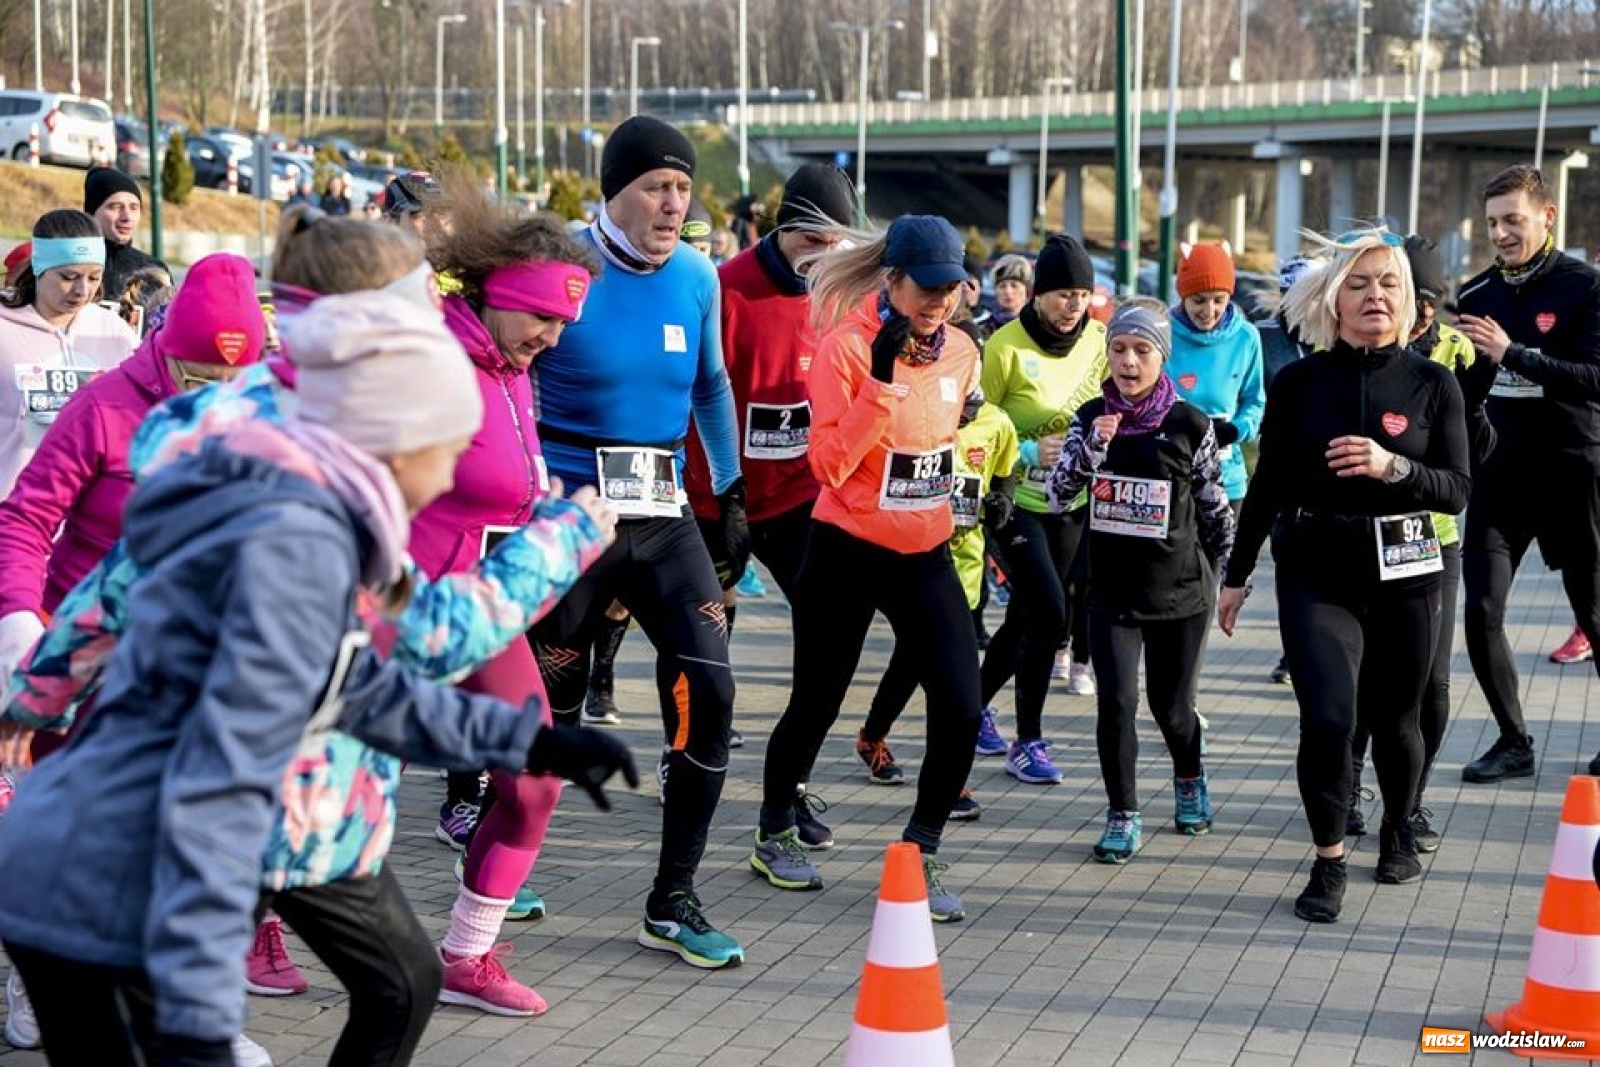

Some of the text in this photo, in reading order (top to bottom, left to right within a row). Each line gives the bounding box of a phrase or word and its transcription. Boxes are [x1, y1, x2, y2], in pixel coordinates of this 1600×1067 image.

[51, 371, 78, 393] 89
[780, 409, 792, 430] 2
[912, 454, 942, 479] 132
[1113, 481, 1147, 505] 149
[1403, 517, 1424, 542] 92
